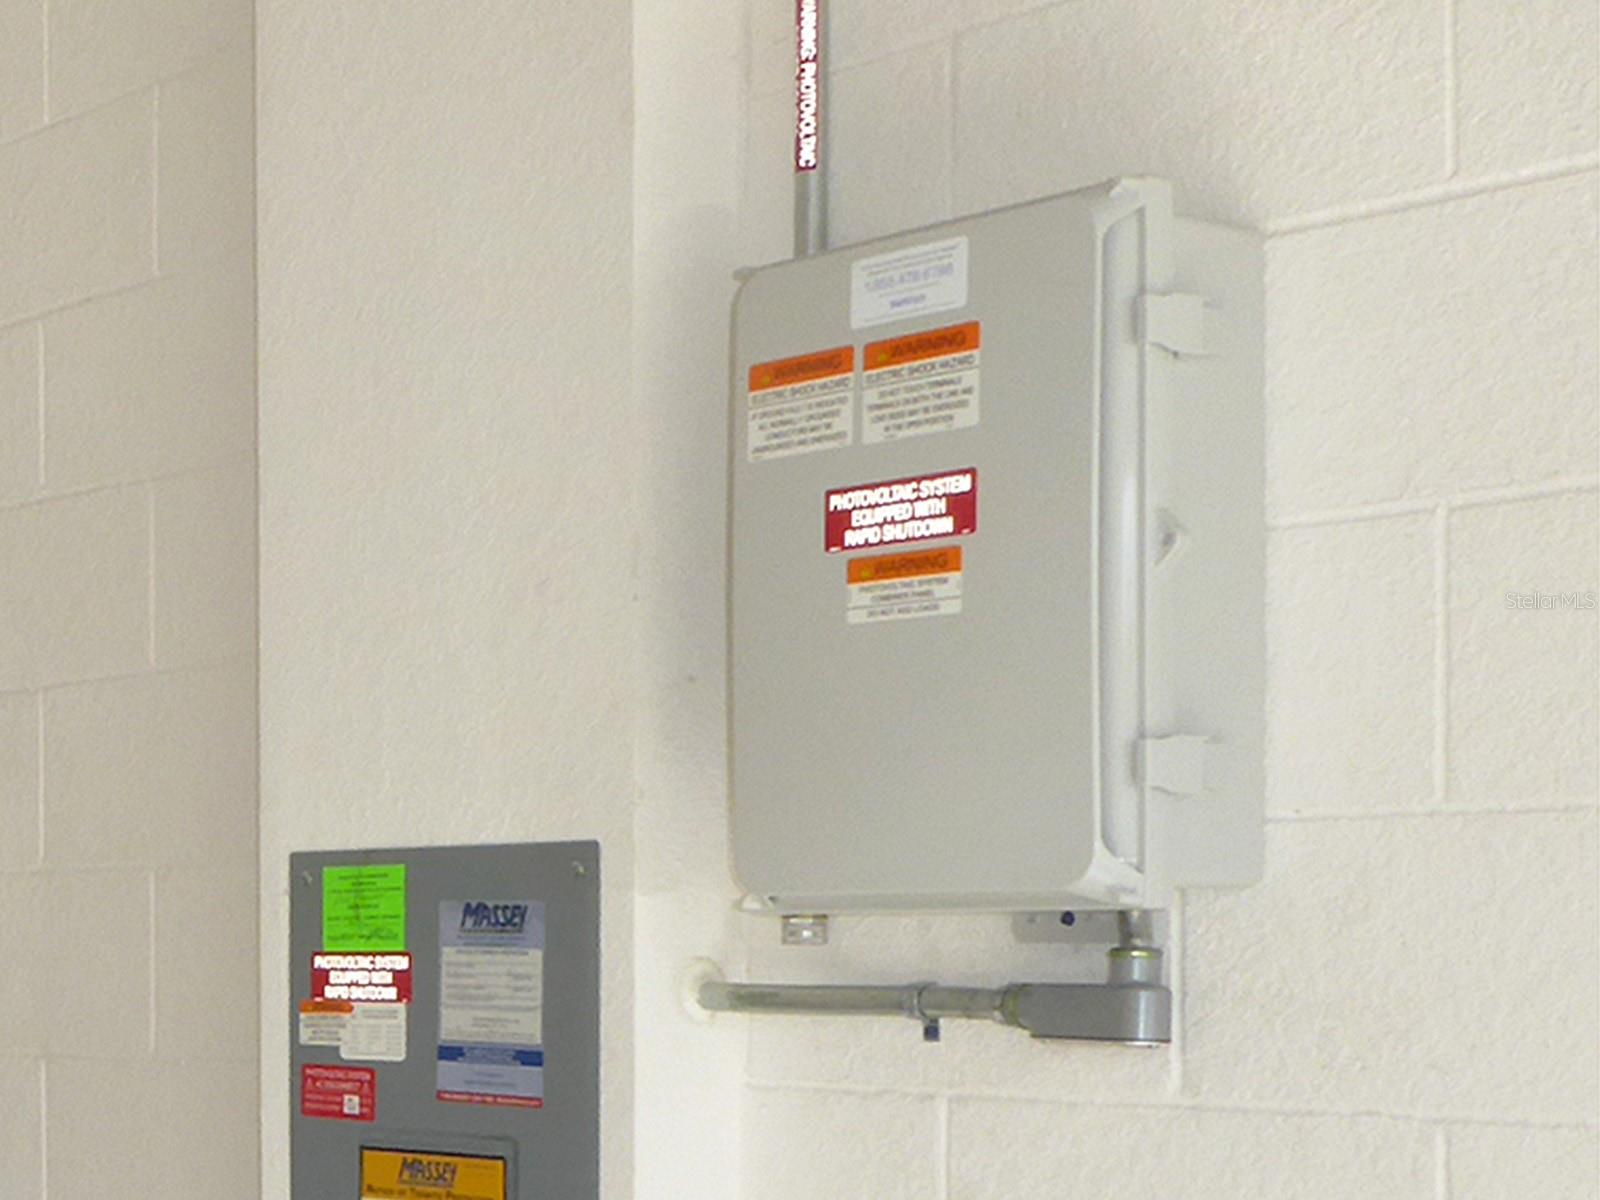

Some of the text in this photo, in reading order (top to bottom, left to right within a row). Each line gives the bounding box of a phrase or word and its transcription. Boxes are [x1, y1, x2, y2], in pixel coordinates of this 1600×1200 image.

[799, 62, 817, 168] PHOTOVOLTAIC
[907, 360, 936, 376] SHOCK
[829, 472, 972, 512] PHOTOVOLTAIC SYSTEM
[851, 497, 946, 527] EQUIPPED WITH
[844, 516, 954, 547] RAPID SHUTDOWN
[460, 902, 528, 928] MASSEY
[398, 1156, 459, 1183] MASSEY
